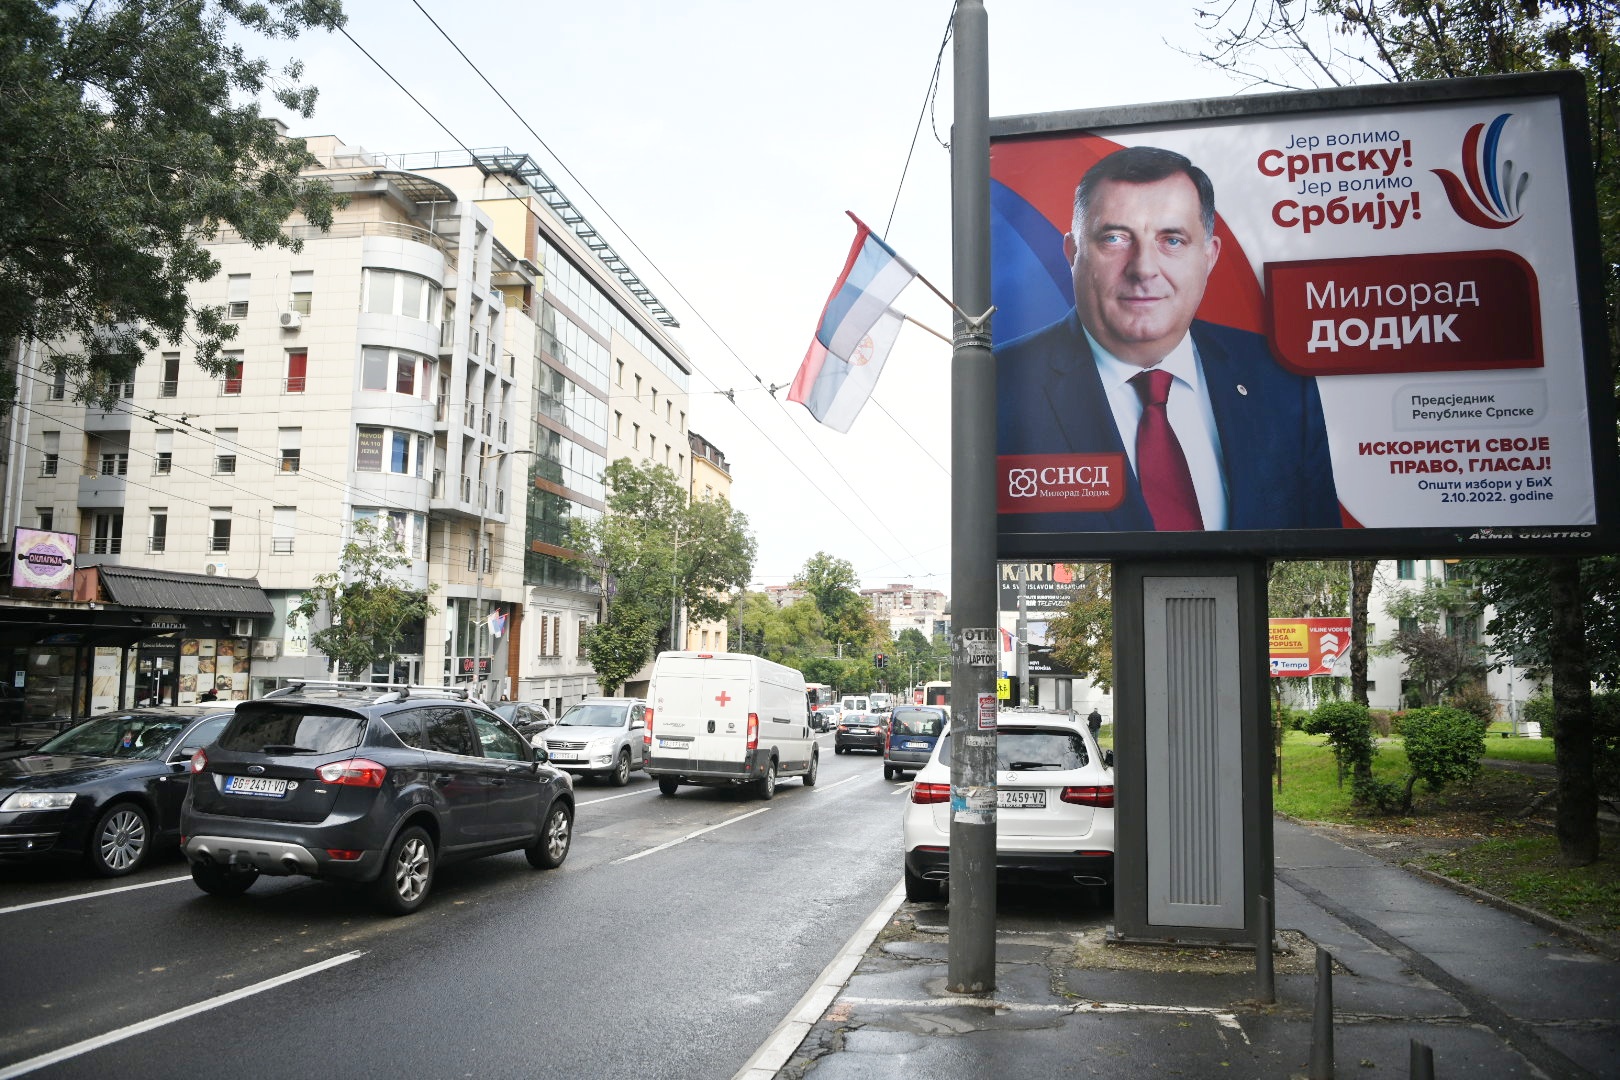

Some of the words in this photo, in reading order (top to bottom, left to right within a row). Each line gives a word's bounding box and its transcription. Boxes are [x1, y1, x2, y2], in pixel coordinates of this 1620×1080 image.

[1286, 134, 1320, 150] Јер
[1326, 130, 1400, 146] волимо
[1257, 139, 1413, 182] Српску!
[1297, 180, 1332, 196] Јер
[1338, 176, 1413, 192] волимо
[1271, 191, 1422, 233] Србију!
[1305, 280, 1480, 312] Милорад
[1307, 313, 1461, 353] ДОДИК
[1411, 394, 1495, 407] Предсједник
[1412, 408, 1483, 421] Републике
[1485, 407, 1534, 420] Српске
[1358, 438, 1481, 456] ИСКОРИСТИ
[1485, 436, 1550, 453] СВОЈЕ
[1389, 458, 1464, 475] ПРАВО,
[1468, 456, 1552, 473] ГЛАСАЈ!
[1040, 466, 1110, 488] СНСД
[1418, 479, 1462, 491] Општи
[1465, 477, 1512, 492] избори
[1514, 479, 1523, 491] у
[1526, 476, 1553, 488] БиХ
[1040, 489, 1080, 498] Милорад
[1081, 488, 1111, 497] Додик
[1441, 491, 1507, 503] 2.10.2022.
[1510, 489, 1554, 503] godine
[1280, 661, 1308, 669] Tempo
[232, 777, 245, 789] BG
